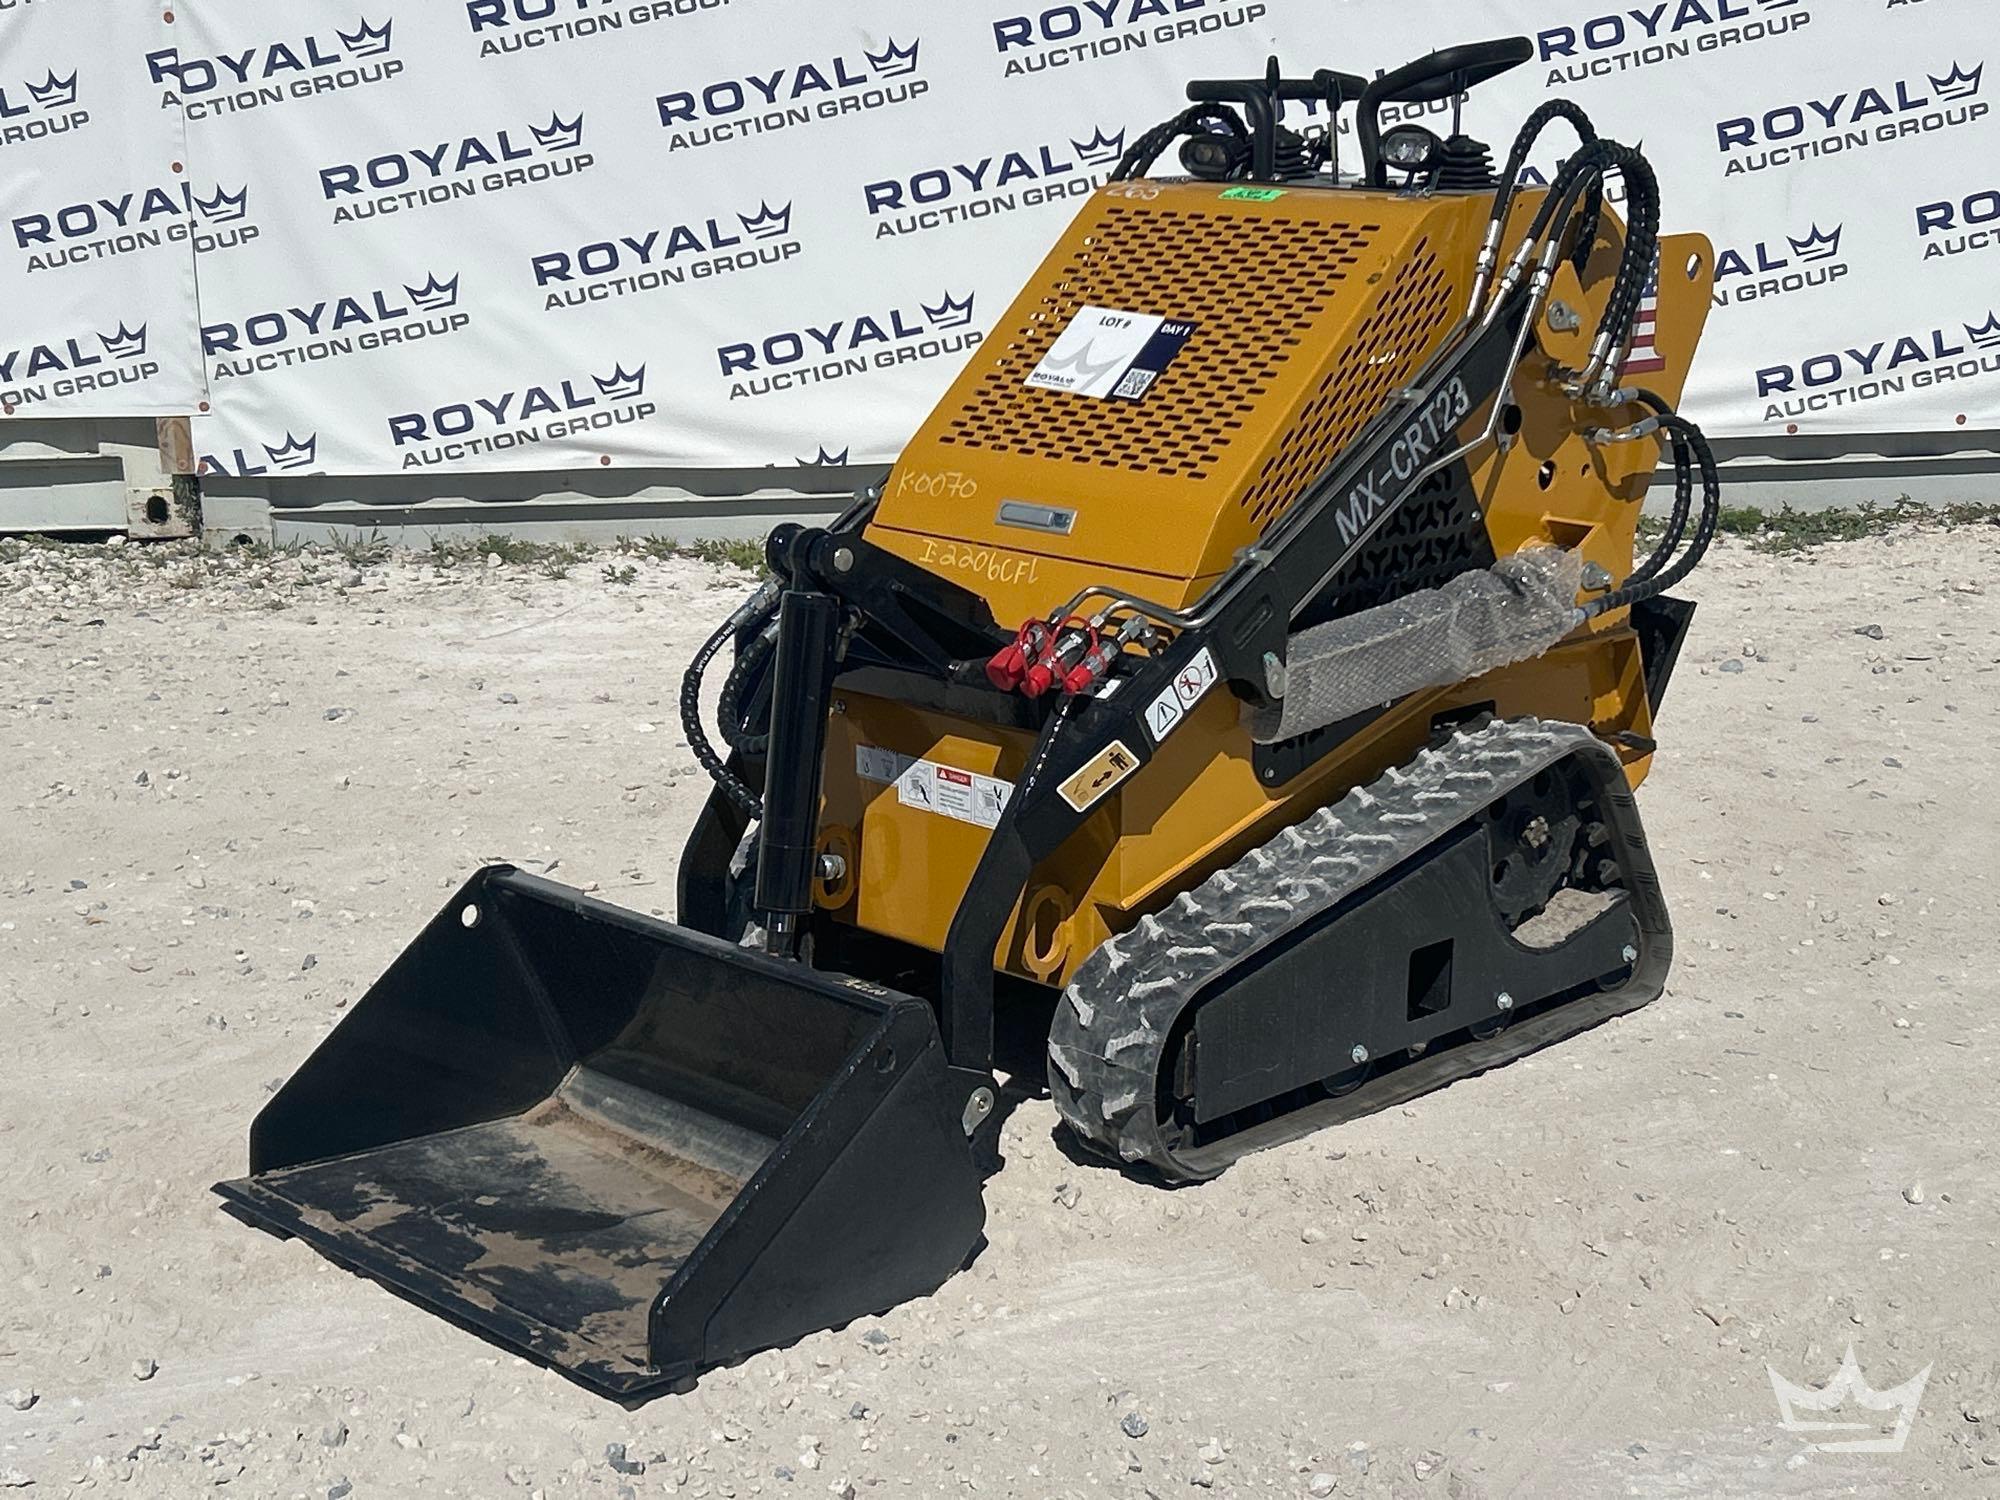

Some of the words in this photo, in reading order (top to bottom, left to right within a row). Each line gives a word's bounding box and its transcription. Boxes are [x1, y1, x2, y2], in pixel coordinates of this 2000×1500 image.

[480, 12, 622, 58] AUCTION
[1004, 30, 1147, 78] AUCTION
[1154, 3, 1266, 43] GROUP
[1546, 39, 1690, 87] AUCTION
[1697, 12, 1810, 52] GROUP
[290, 59, 404, 97] GROUP
[656, 57, 867, 127] ROYAL
[0, 111, 90, 146] ROUP
[669, 106, 811, 152] AUCTION
[817, 80, 929, 119] GROUP
[1717, 81, 1928, 152] ROYAL
[1724, 130, 1868, 177] AUCTION
[1876, 102, 1989, 142] GROUP
[319, 130, 533, 200] ROYAL
[333, 179, 475, 225] AUCTION
[482, 153, 595, 192] GROUP
[864, 145, 1073, 215] ROYAL
[875, 193, 1016, 240] AUCTION
[1022, 171, 1112, 207] GROU
[26, 228, 160, 273] AUCTION
[167, 224, 260, 254] GOUP
[531, 219, 740, 286] ROYAL
[545, 266, 685, 311] AUCTION
[691, 241, 801, 279] GROUP
[1736, 263, 1848, 302] GROUP
[203, 290, 409, 356] ROYAL
[213, 337, 353, 380] AUCTION
[359, 312, 470, 350] GROUP
[717, 309, 924, 377] ROYAL
[1099, 316, 1124, 328] LOT
[1160, 323, 1184, 335] DAY
[53, 361, 159, 398] GROUP
[729, 356, 867, 400] AUCTION
[874, 331, 983, 369] GROUP
[1755, 330, 1965, 397] ROYAL
[1763, 376, 1905, 422] AUCTION
[1912, 354, 2000, 387] GROU
[388, 380, 596, 445] ROYAL
[402, 427, 540, 469] AUCTION
[546, 402, 656, 439] GROUP
[1334, 374, 1472, 547] MX-CRT23
